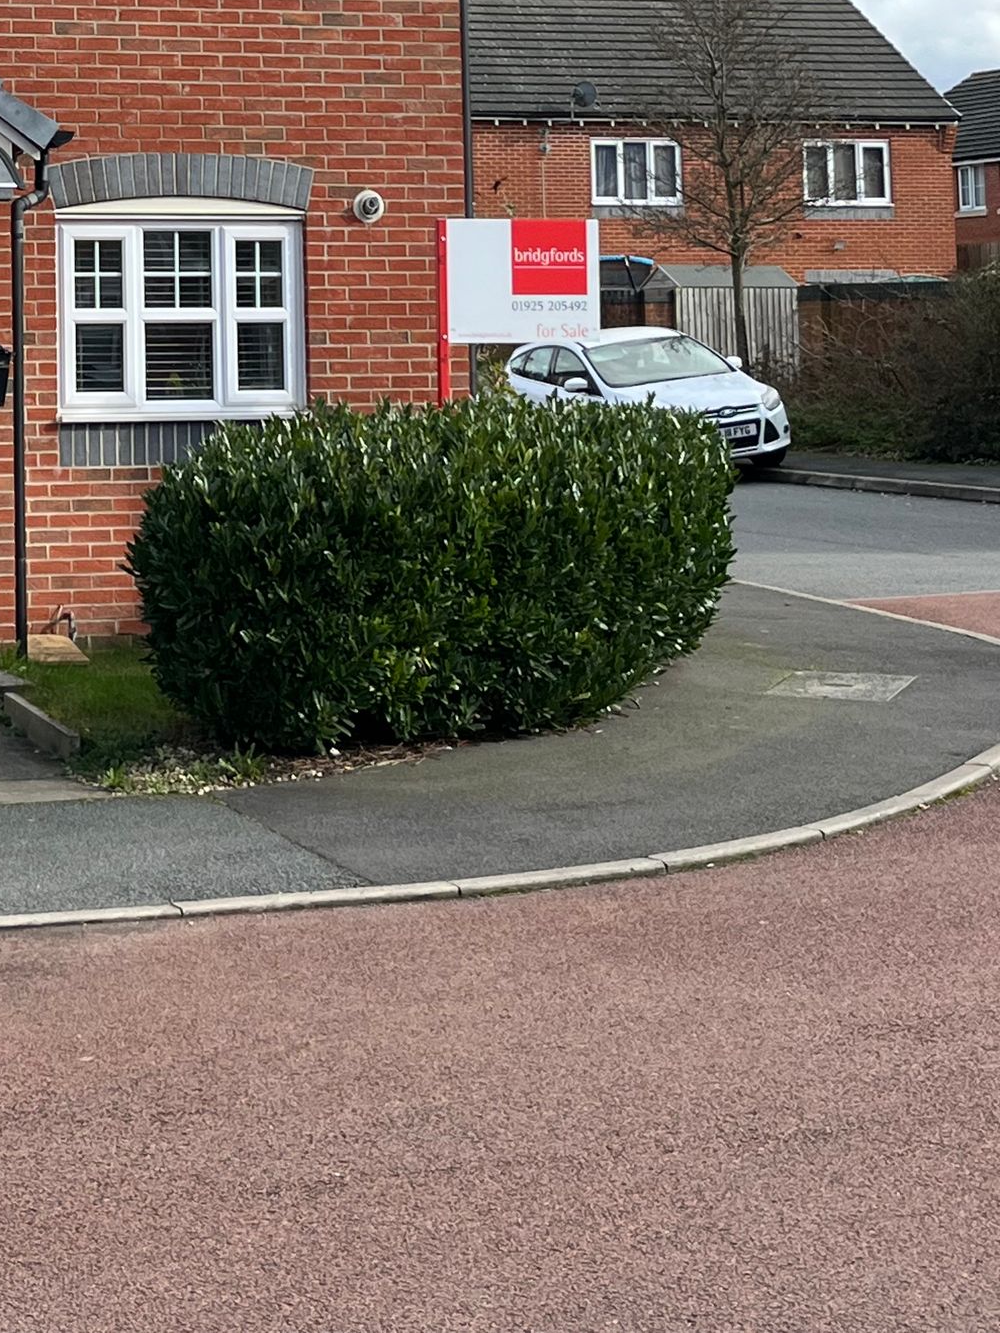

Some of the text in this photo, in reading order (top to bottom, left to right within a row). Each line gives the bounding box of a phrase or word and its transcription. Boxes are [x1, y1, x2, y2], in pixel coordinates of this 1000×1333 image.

[514, 247, 585, 266] bridgfords
[511, 300, 588, 312] 01925 205492
[536, 322, 588, 338] for Sale
